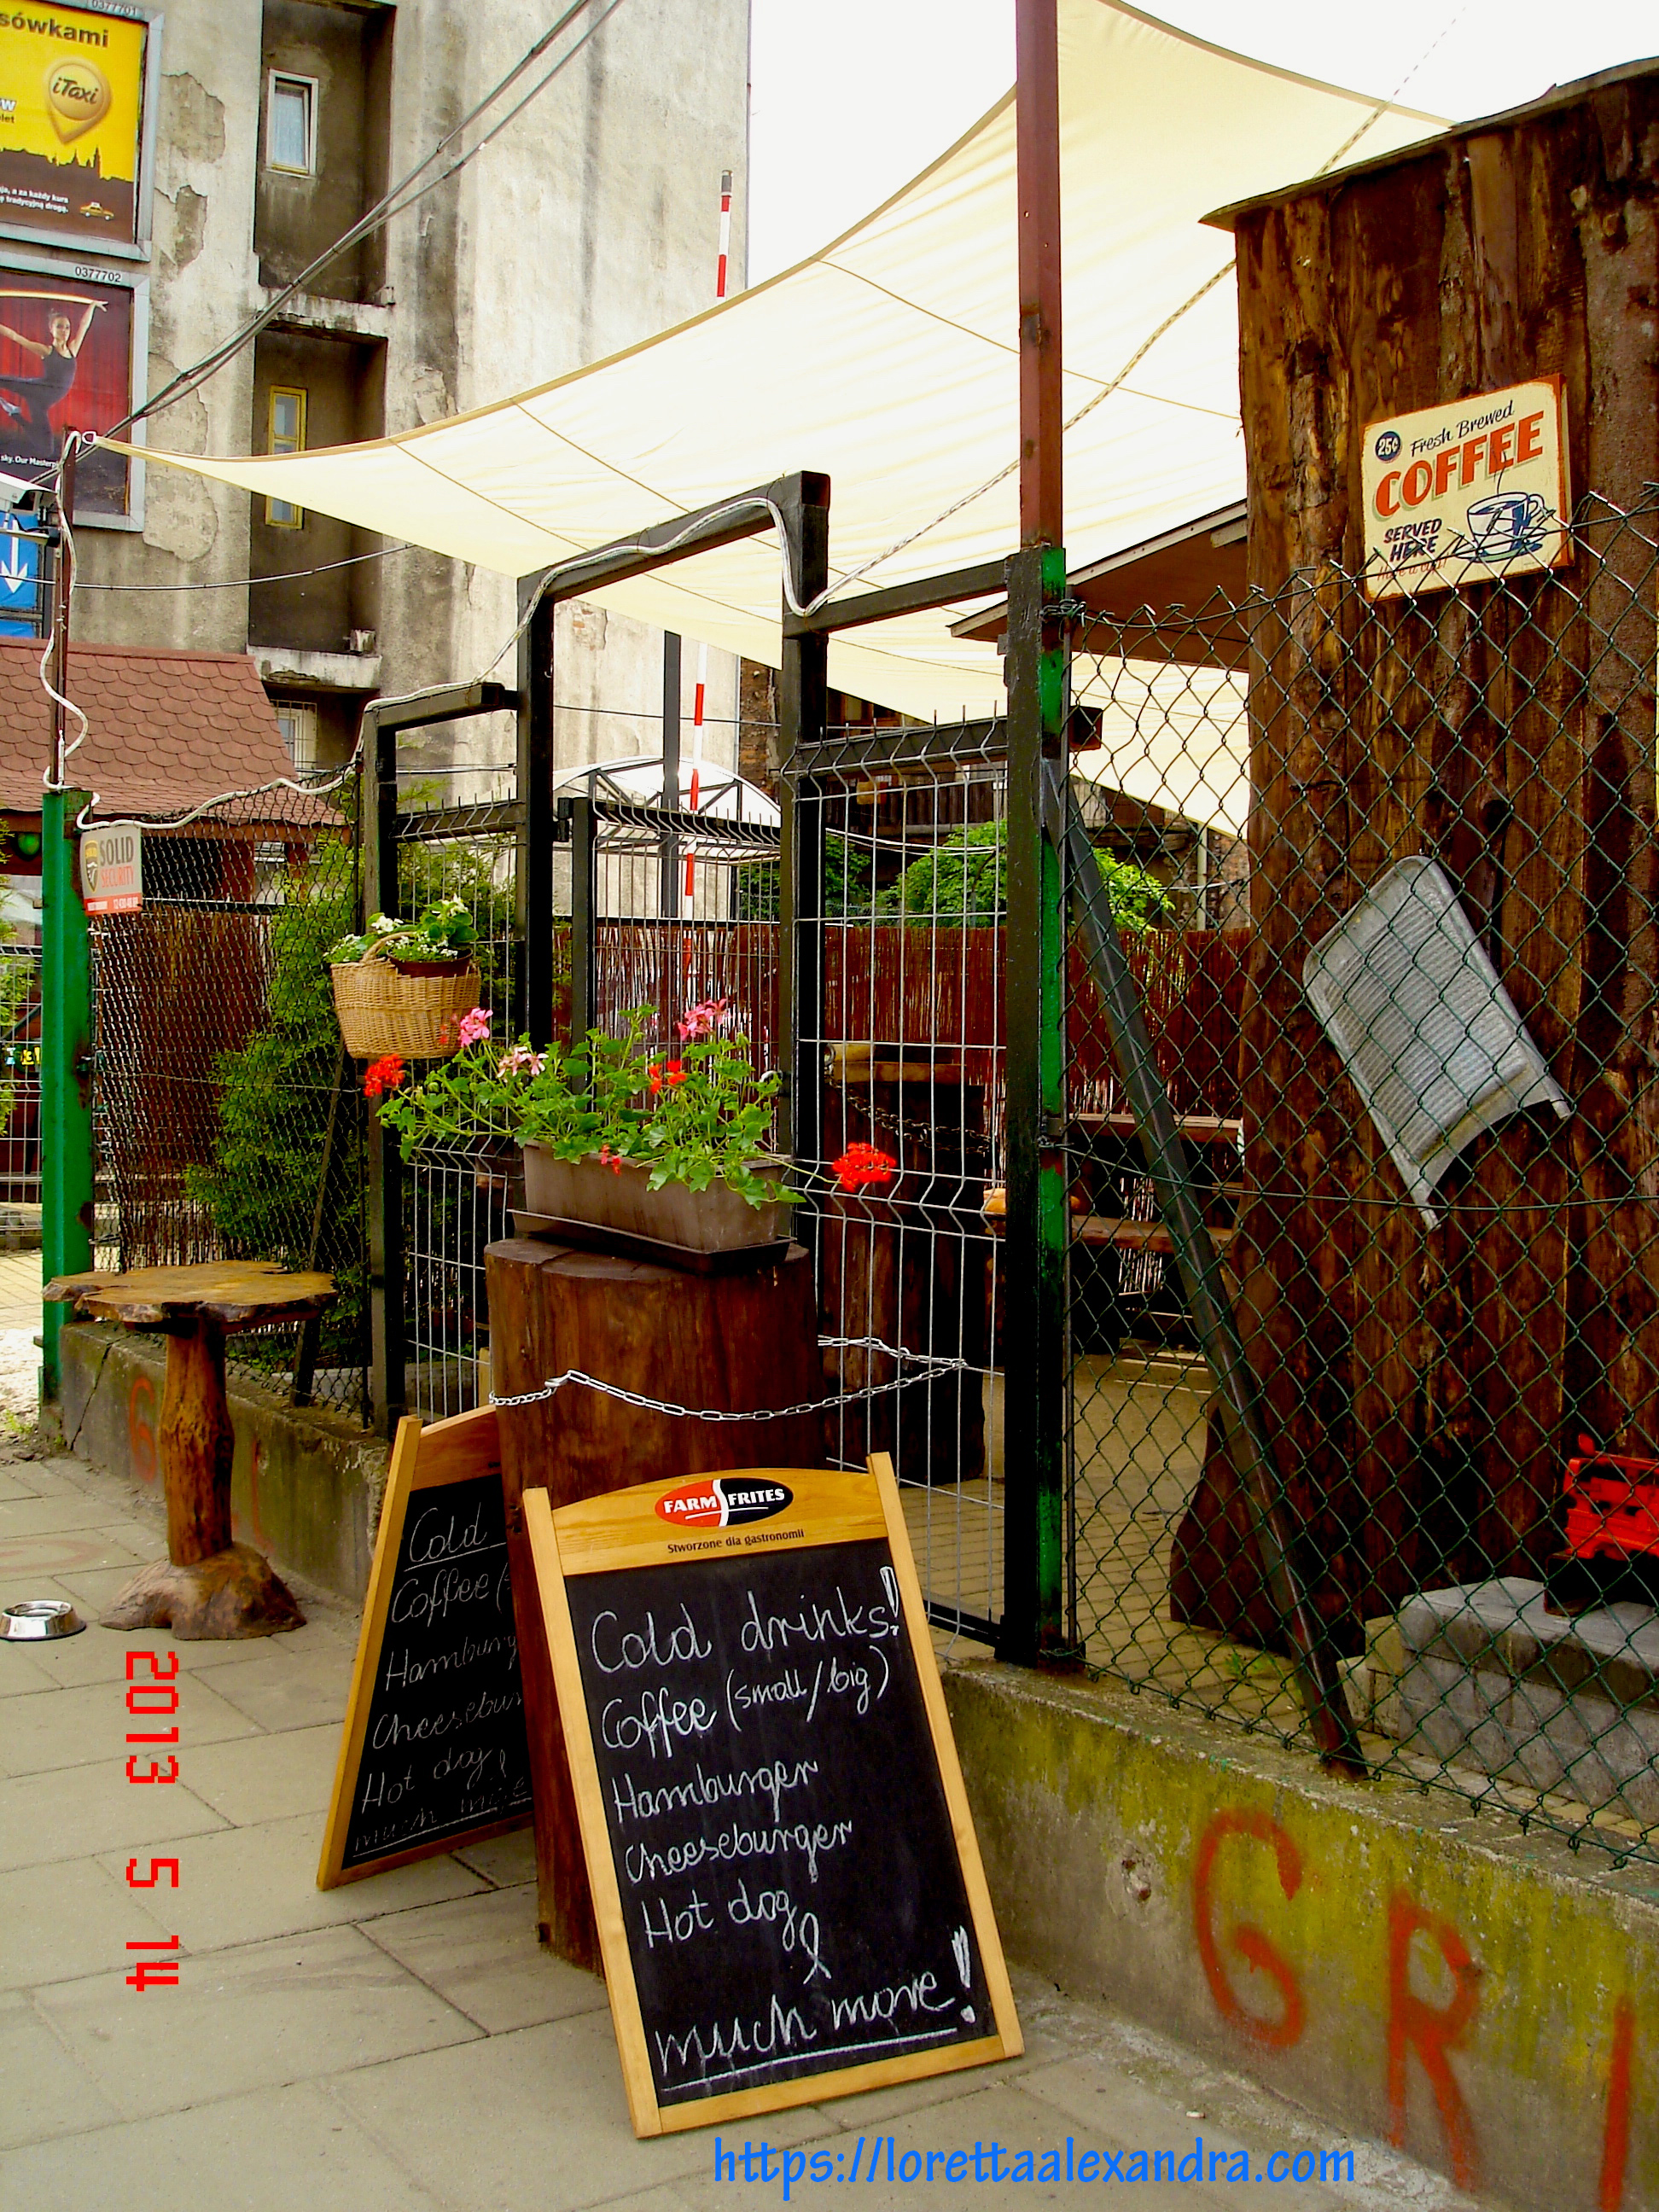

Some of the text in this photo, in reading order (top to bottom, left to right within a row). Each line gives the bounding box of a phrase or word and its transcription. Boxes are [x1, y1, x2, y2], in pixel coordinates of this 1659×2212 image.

[52, 78, 99, 105] iTaxi
[75, 265, 122, 282] 0377702
[1377, 436, 1400, 457] 25¢
[1409, 399, 1516, 457] Fresh Brewed
[15, 455, 28, 464] Our
[29, 457, 59, 469] Masterp
[1374, 410, 1545, 520] COFFEE
[1383, 518, 1442, 544] SERVED
[1389, 535, 1439, 562] HERE
[100, 835, 134, 867] SOLID
[101, 865, 134, 888] SECURITY
[663, 1487, 785, 1514] FARM FRITES
[409, 1501, 487, 1563] Cold
[667, 1528, 805, 1554] Stworzone dla gastronomii
[391, 1568, 490, 1627] Coffee
[591, 1565, 900, 1674] Cold drinks!
[601, 1686, 718, 1758] Coffee
[361, 1747, 493, 1814] Hot dog
[610, 1760, 819, 1824] Hamburger
[624, 1819, 853, 1884] Cheeseburger
[641, 1877, 798, 1952] Hot dog
[655, 1994, 818, 2077] much
